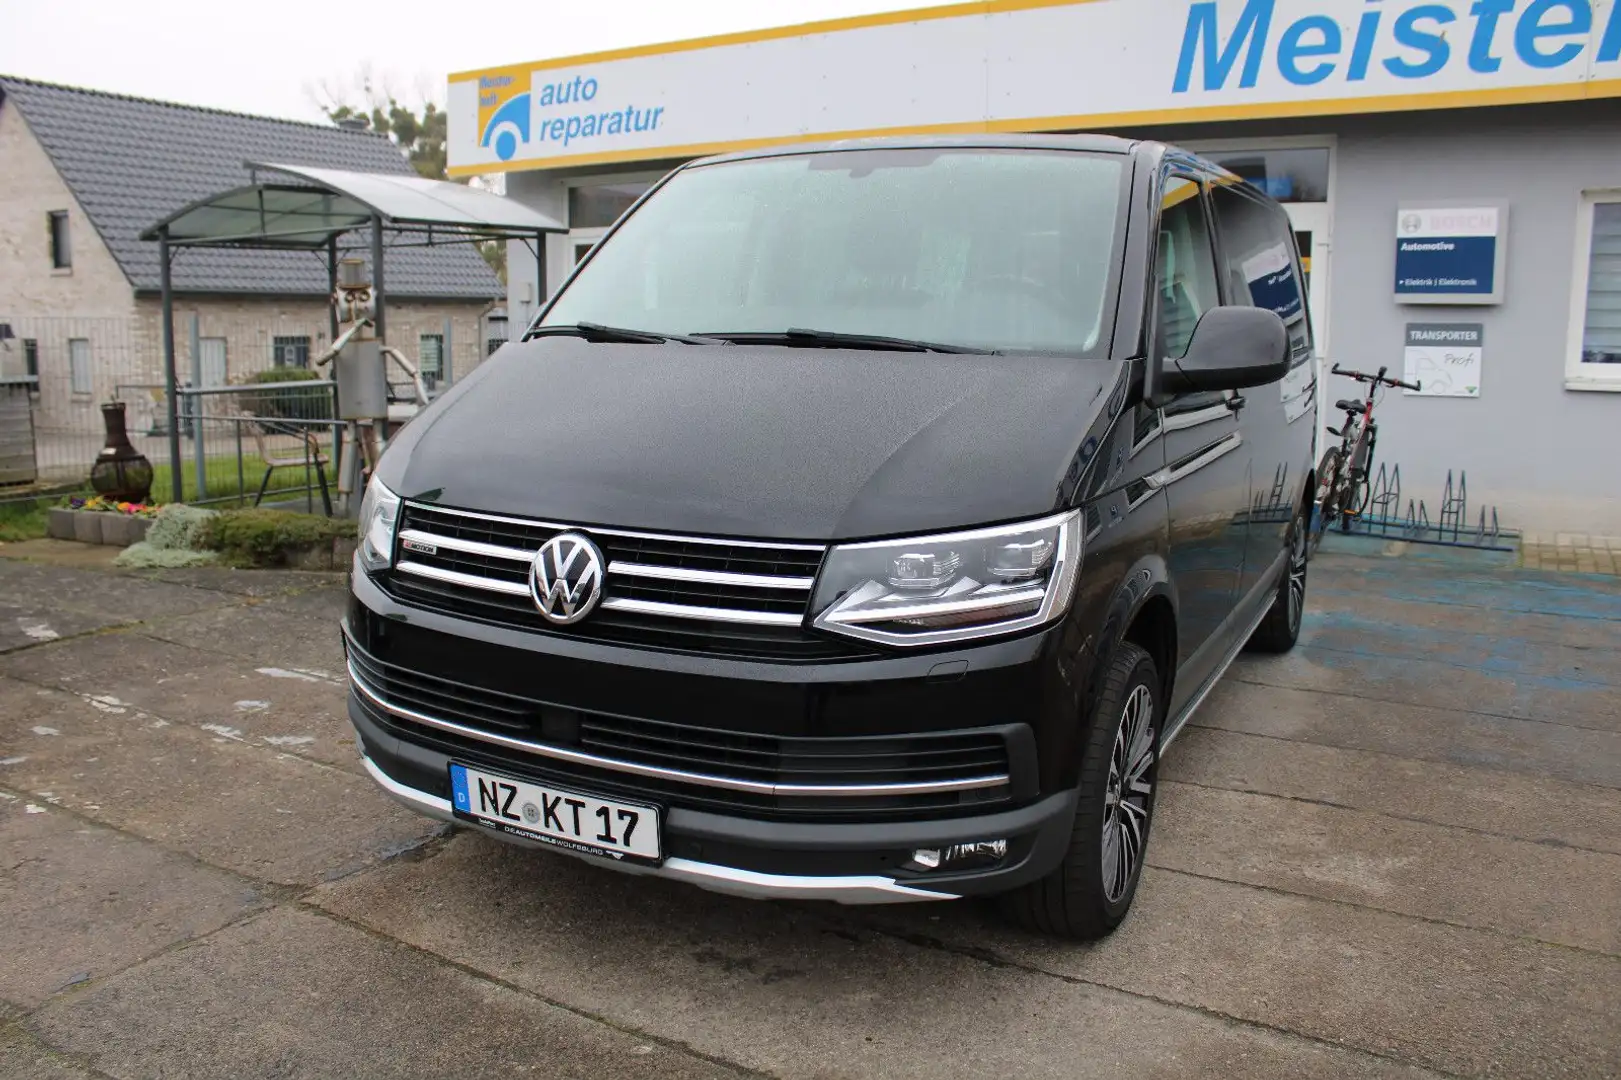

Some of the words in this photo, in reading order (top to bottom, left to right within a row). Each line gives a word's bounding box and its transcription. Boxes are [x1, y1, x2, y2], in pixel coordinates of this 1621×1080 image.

[540, 75, 598, 106] auto
[540, 105, 664, 147] reparatur
[1430, 215, 1492, 231] BOSCH
[1400, 241, 1455, 251] Automotive
[1438, 278, 1477, 286] Elektronik
[1410, 330, 1478, 341] TRANSPORTER
[459, 792, 465, 802] D
[478, 777, 521, 822] NZ
[541, 792, 586, 836] KT
[595, 805, 639, 847] 17
